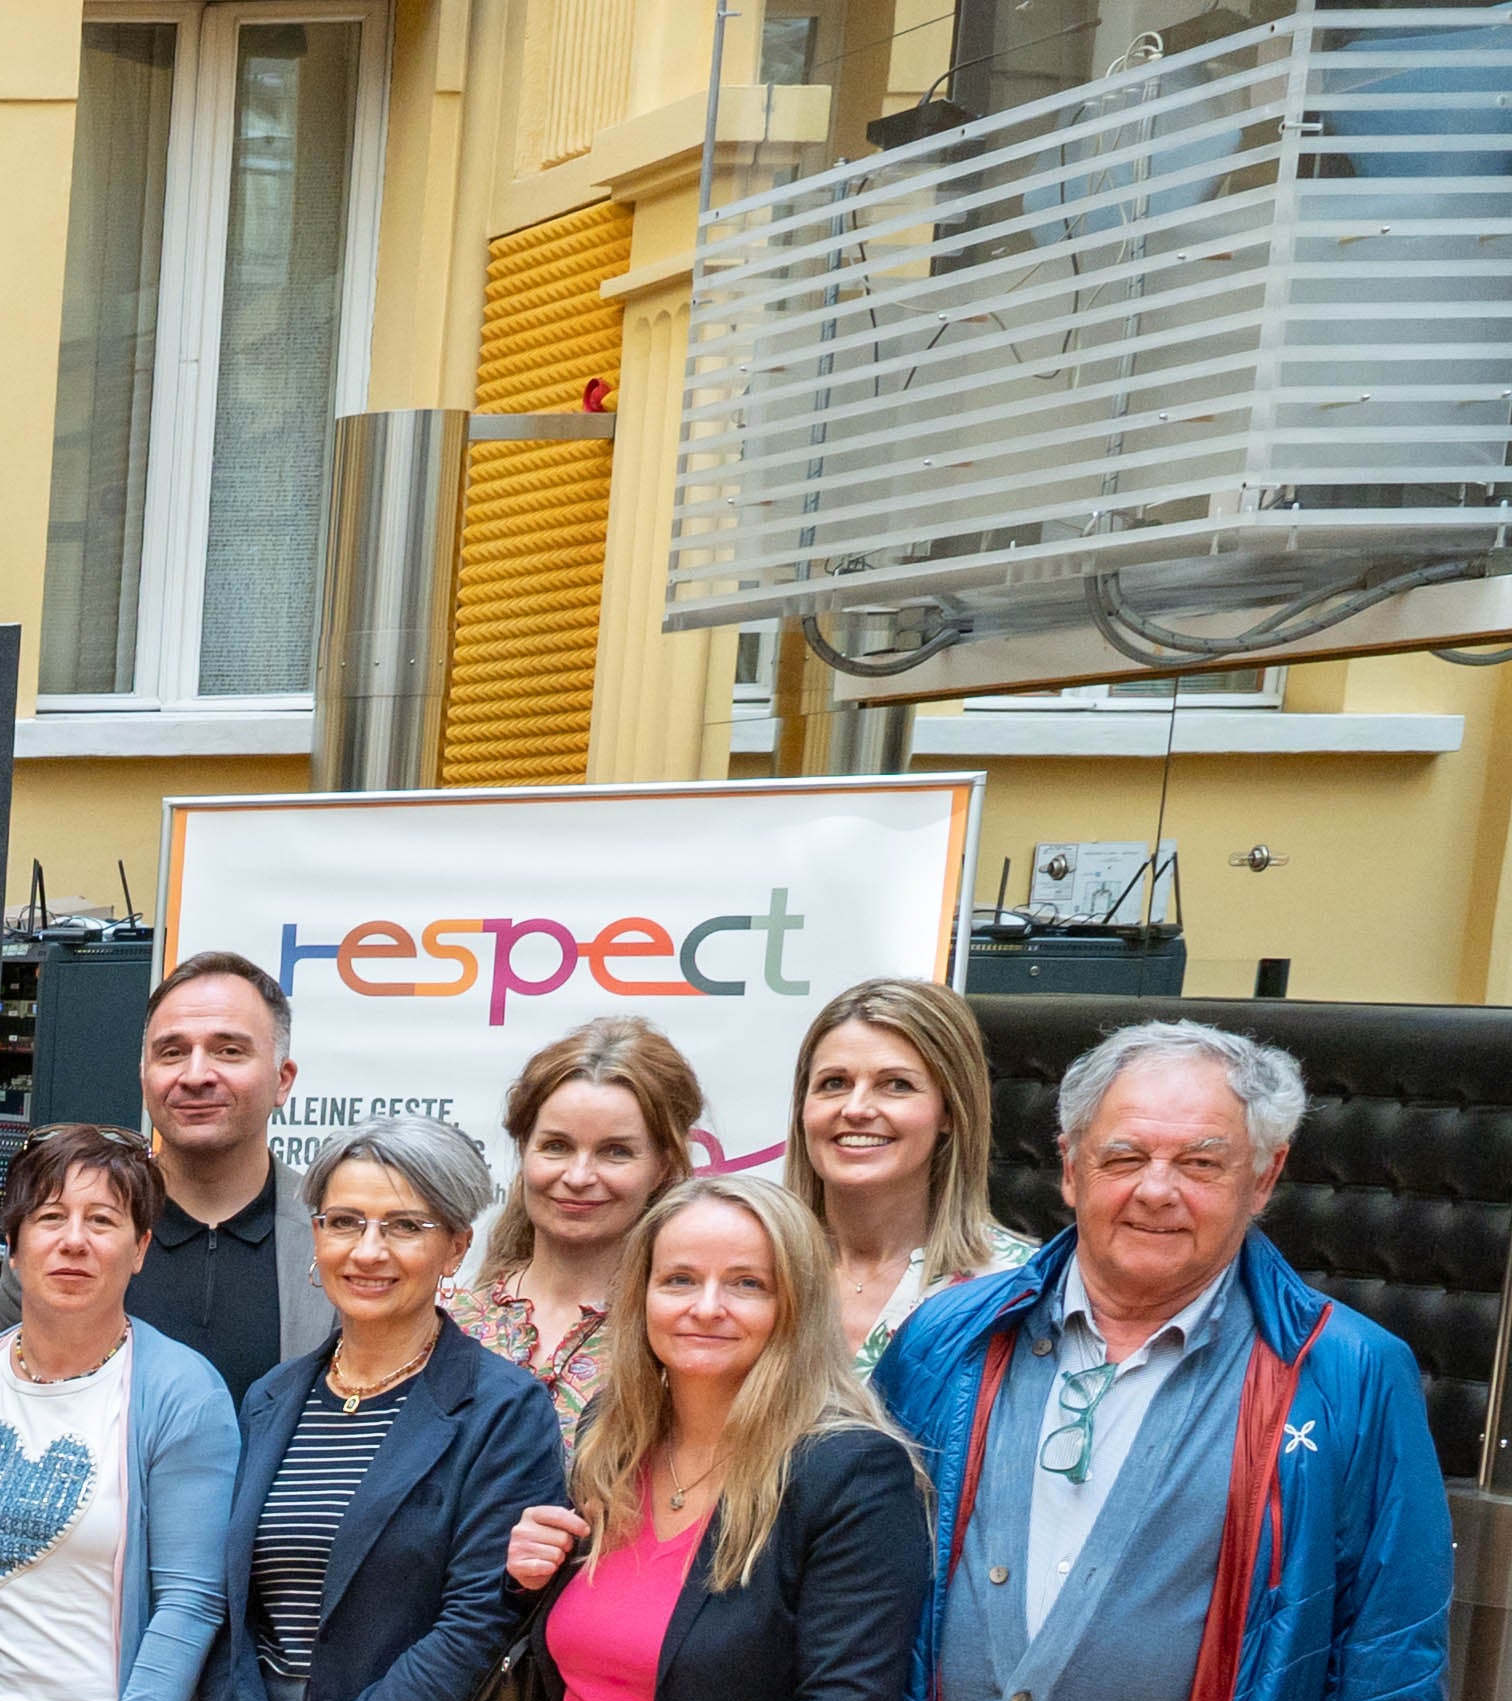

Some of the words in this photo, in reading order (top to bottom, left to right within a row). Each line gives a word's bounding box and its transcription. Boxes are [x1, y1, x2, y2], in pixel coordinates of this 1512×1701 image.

[279, 887, 810, 1026] respect
[271, 1096, 364, 1127] KLEINE
[269, 1136, 333, 1166] GRO
